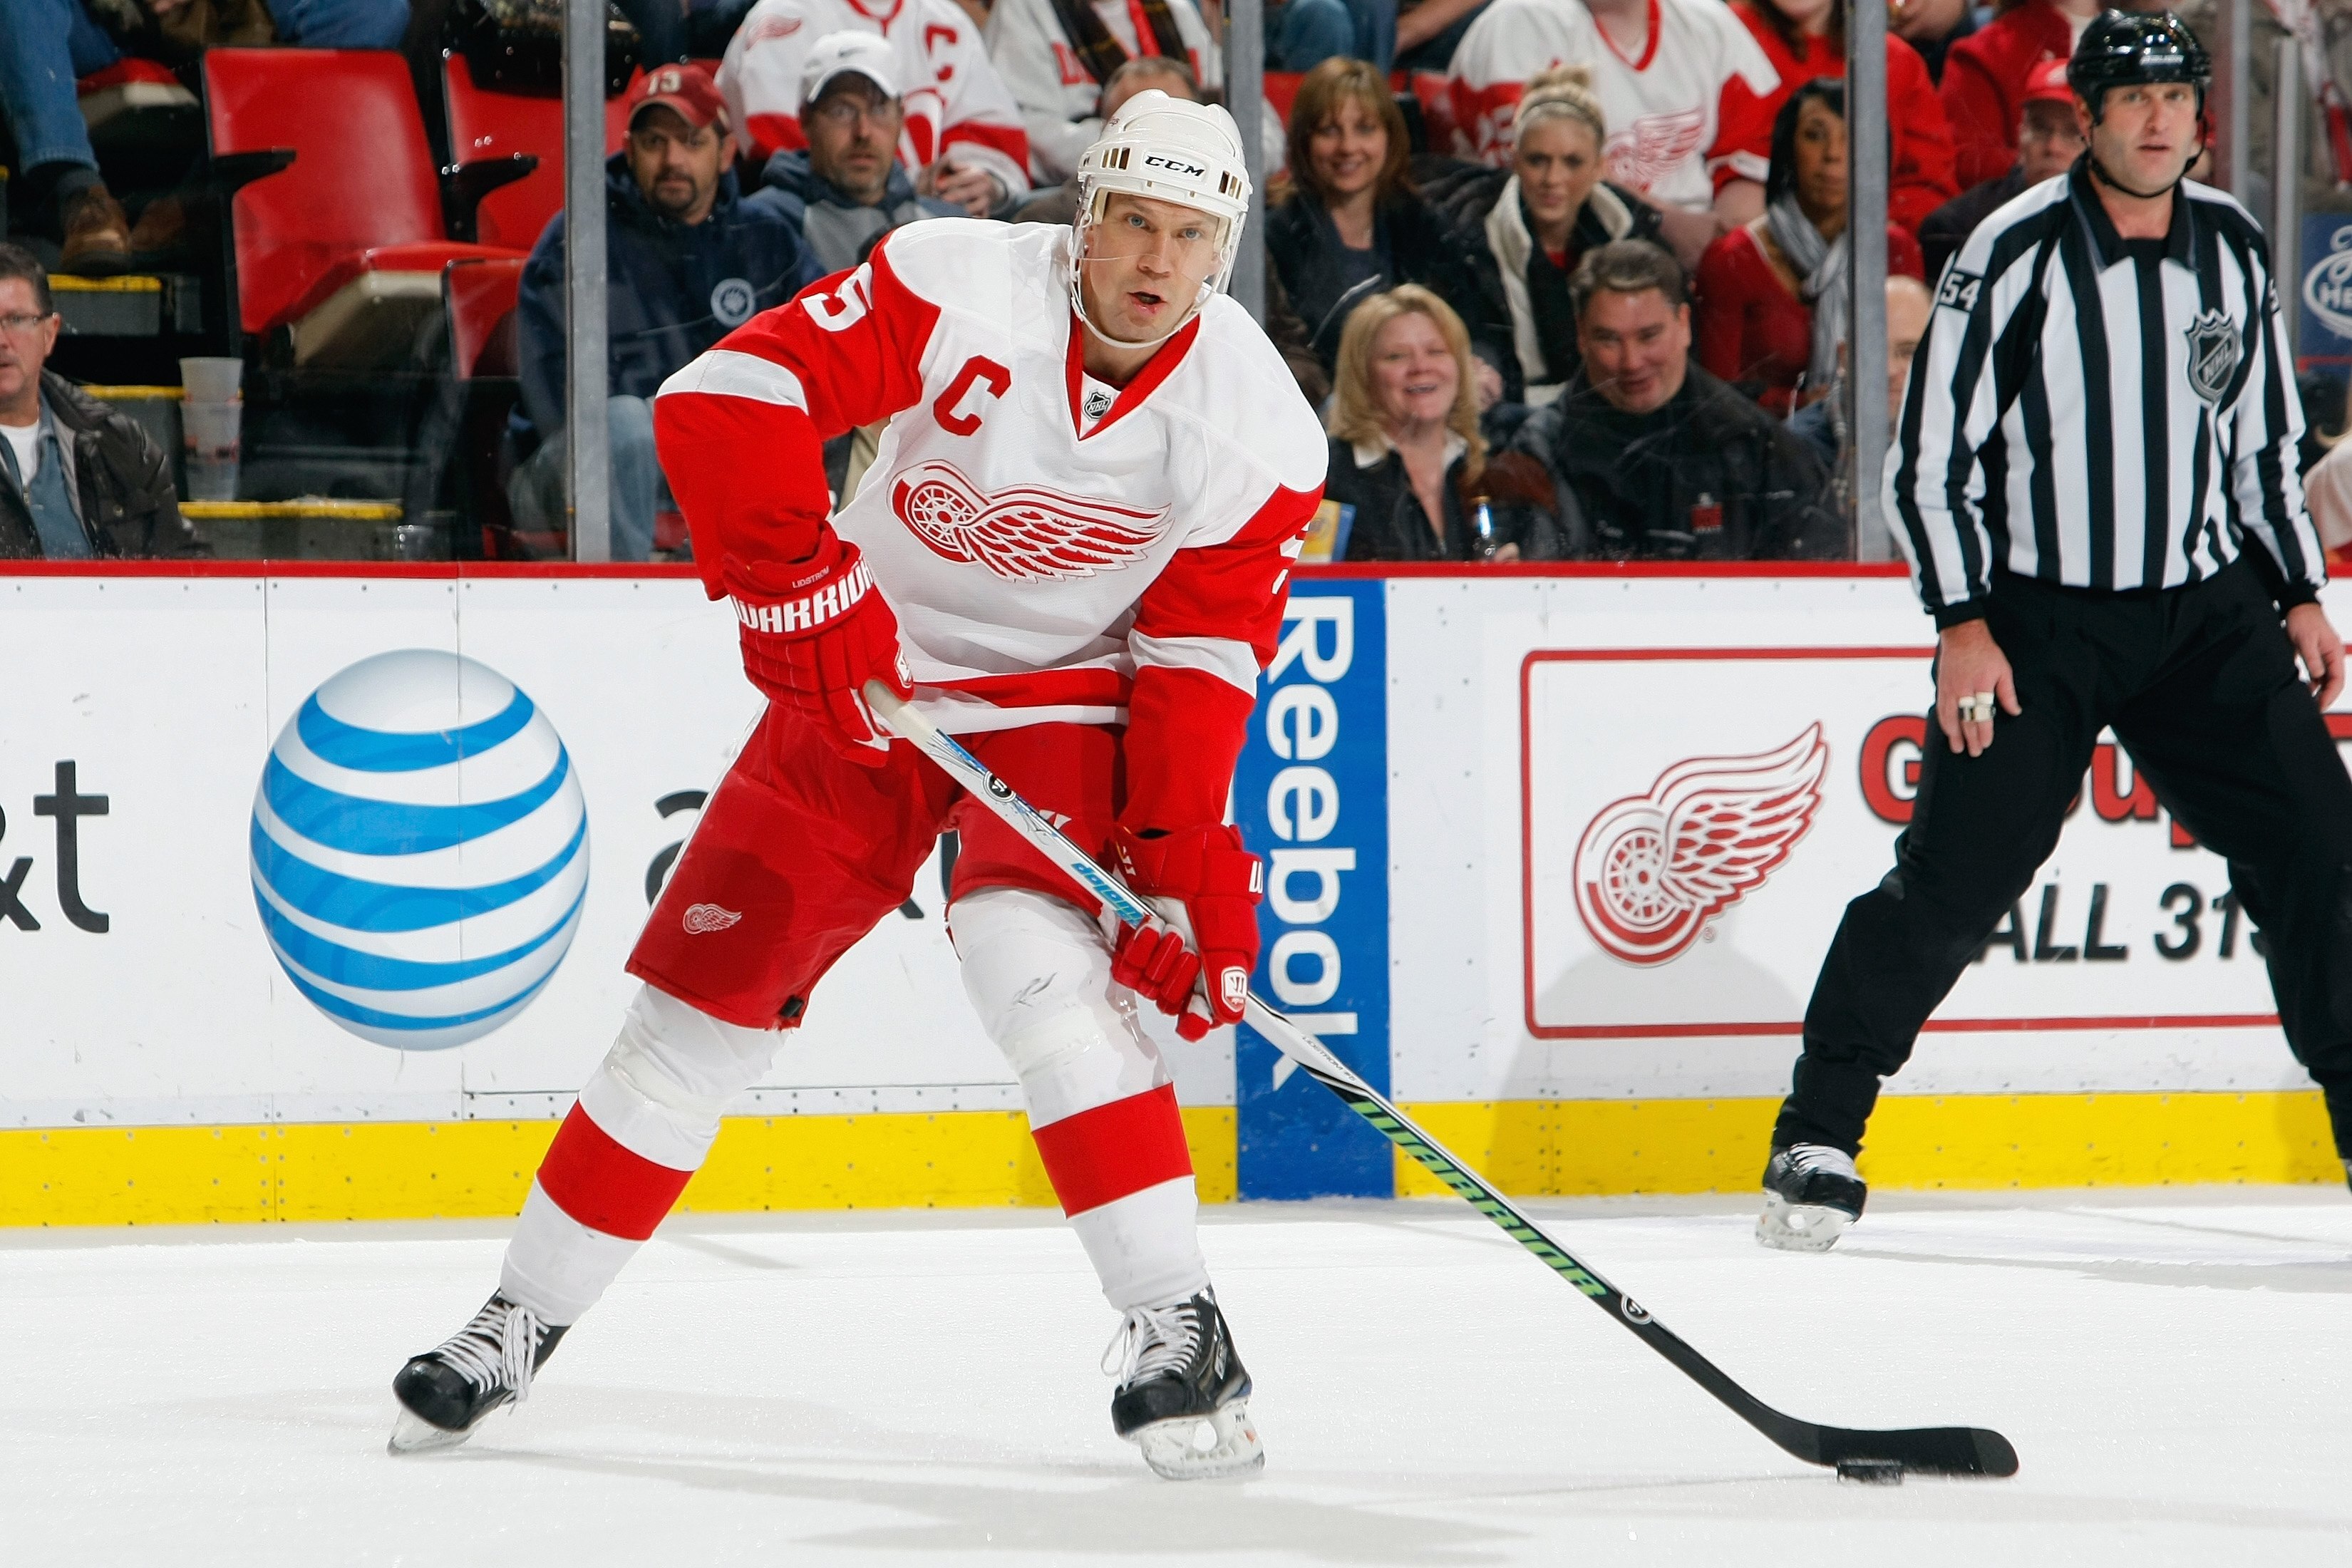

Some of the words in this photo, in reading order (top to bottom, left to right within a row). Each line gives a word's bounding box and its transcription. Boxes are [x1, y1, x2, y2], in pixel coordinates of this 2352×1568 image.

[1144, 155, 1205, 177] CCM
[1939, 272, 1982, 311] 54
[933, 355, 1011, 437] C
[792, 566, 830, 589] LIDSTROM
[1267, 596, 1358, 1092] Reebok
[1970, 884, 2130, 964] ALL
[2153, 882, 2268, 962] 31
[1349, 1100, 1609, 1297] WARRIOR
